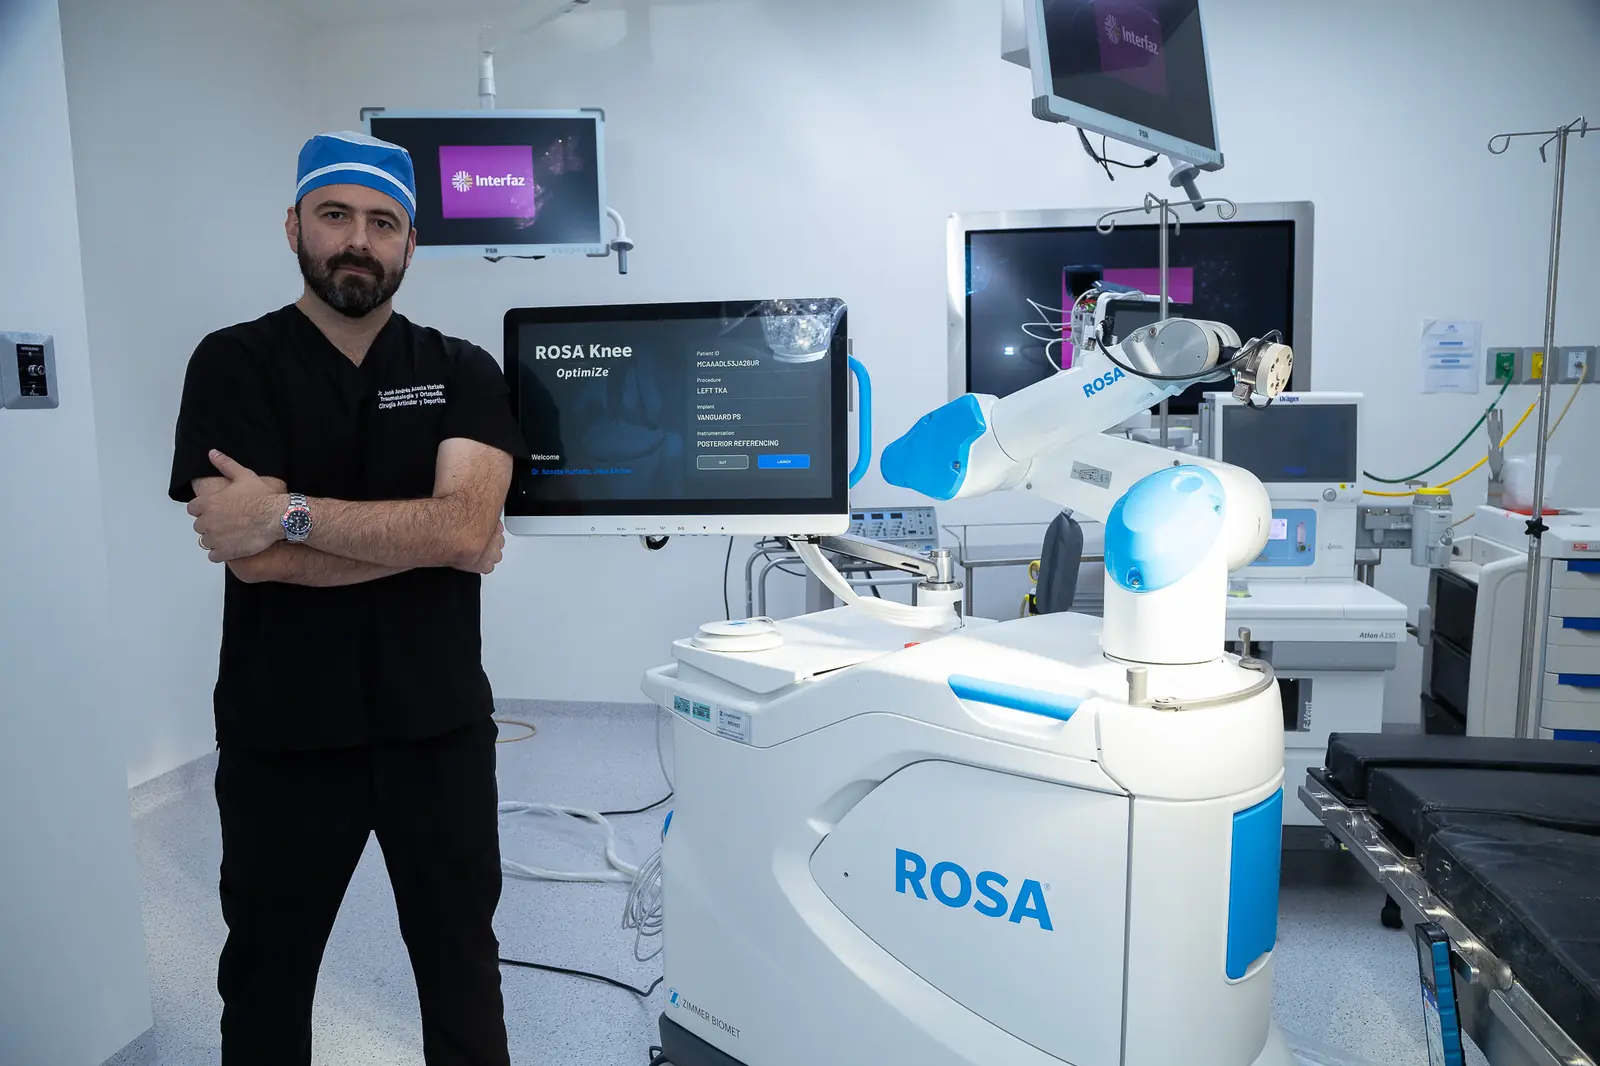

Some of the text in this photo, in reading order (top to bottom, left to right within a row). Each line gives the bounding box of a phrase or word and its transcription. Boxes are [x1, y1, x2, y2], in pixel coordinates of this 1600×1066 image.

[1122, 27, 1159, 55] Interfaz
[475, 173, 525, 187] Interfaz
[535, 344, 633, 360] ROSA Knee
[556, 367, 610, 379] OptimiZe
[1082, 366, 1126, 398] ROSA
[696, 413, 732, 421] VANGUARD
[733, 439, 779, 447] REFERENCING
[895, 847, 1054, 932] ROSA
[682, 998, 711, 1022] ZIMMER
[711, 1015, 741, 1039] BIOMET
